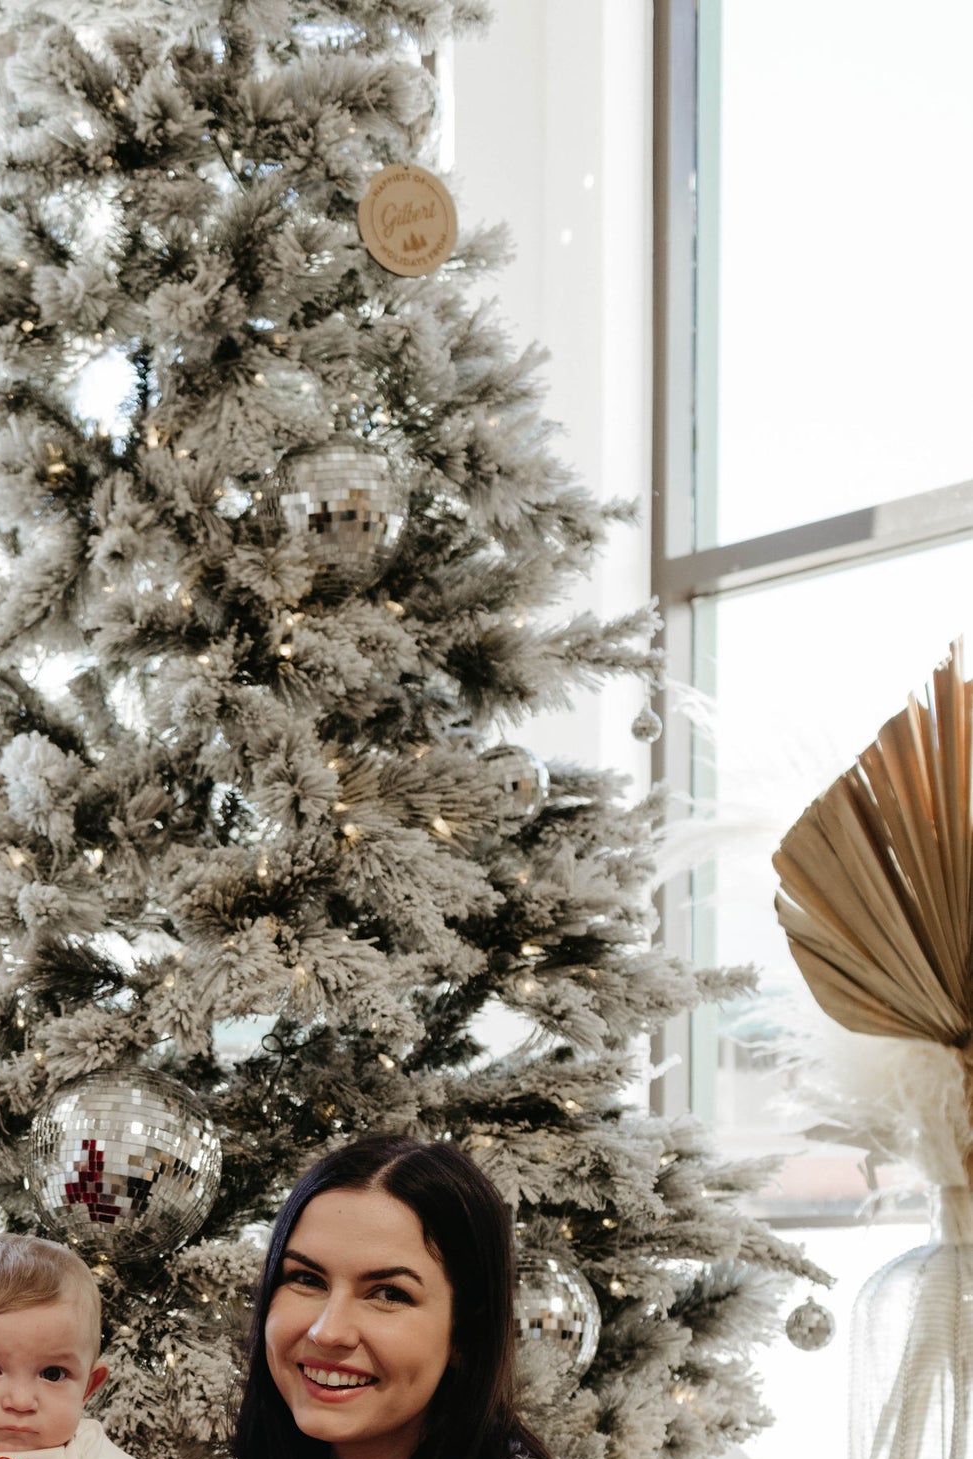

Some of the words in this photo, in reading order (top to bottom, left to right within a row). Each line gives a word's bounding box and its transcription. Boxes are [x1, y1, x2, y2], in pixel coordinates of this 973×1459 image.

[372, 173, 411, 198] HAPPIEST
[413, 175, 426, 184] OF
[380, 200, 436, 239] Gilbert
[380, 244, 428, 267] HOLIDAYS
[428, 233, 448, 260] FROM
